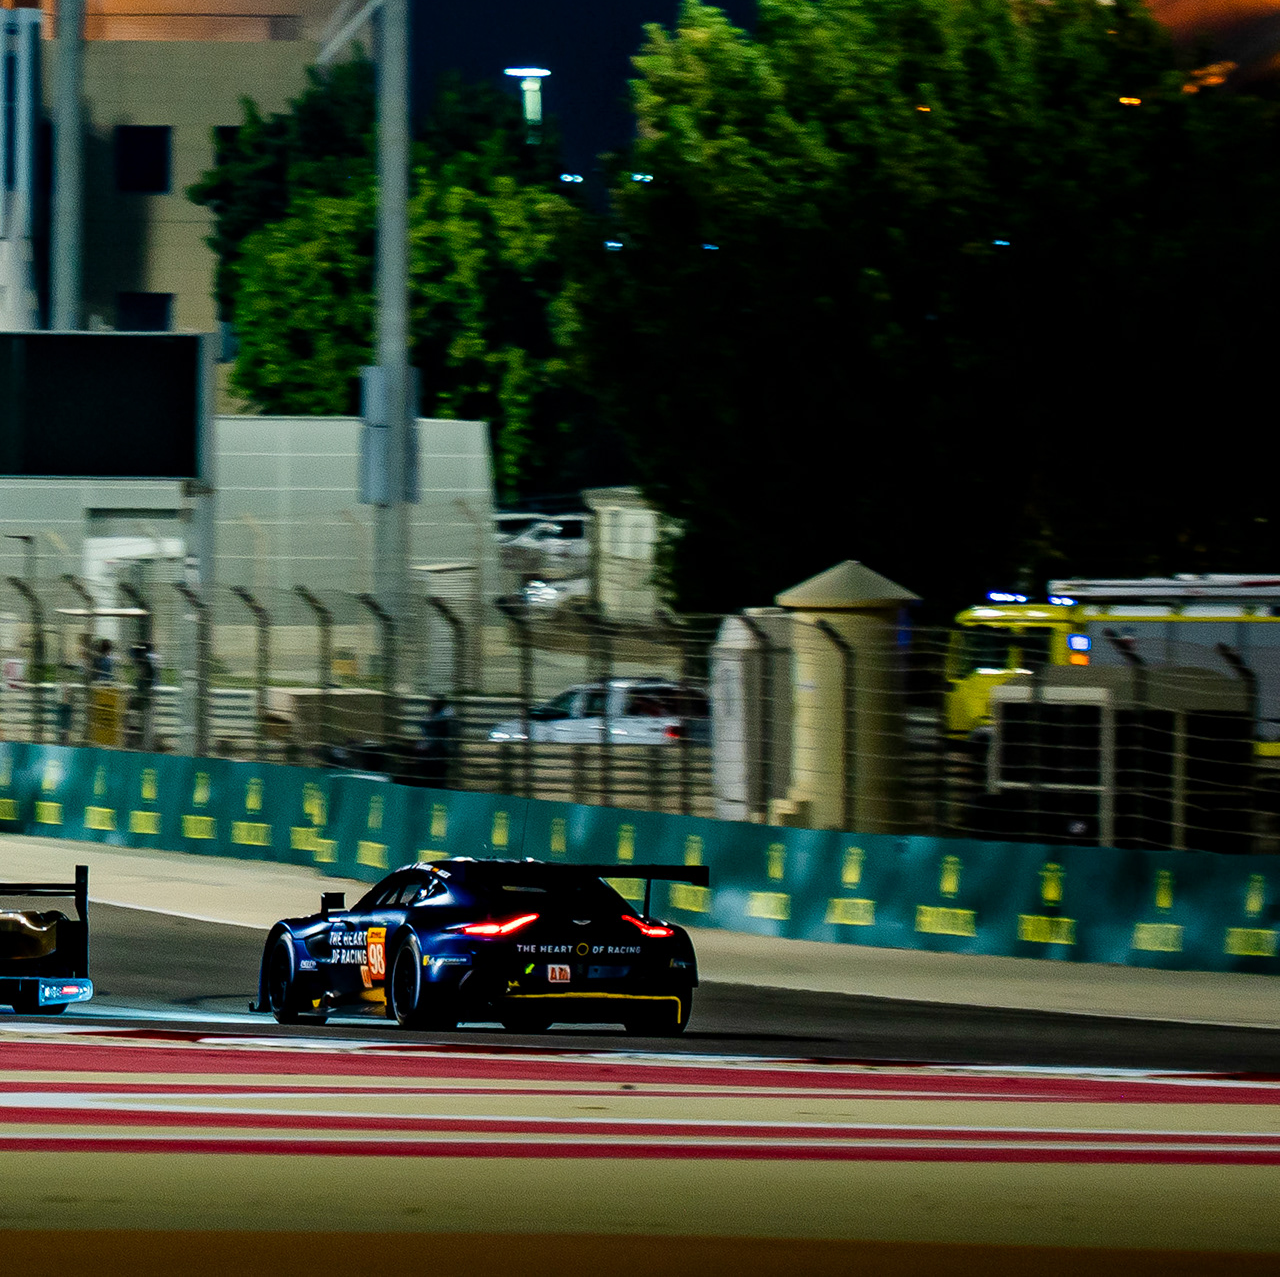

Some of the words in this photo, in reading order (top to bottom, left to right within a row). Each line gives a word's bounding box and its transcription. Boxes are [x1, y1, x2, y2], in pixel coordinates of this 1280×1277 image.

[330, 932, 342, 945] THE
[343, 932, 368, 945] HEART
[341, 949, 367, 964] RACING
[517, 945, 536, 953] THE
[540, 945, 573, 953] HEART
[592, 946, 604, 954] OF
[608, 946, 641, 954] RACING
[370, 944, 385, 974] 98
